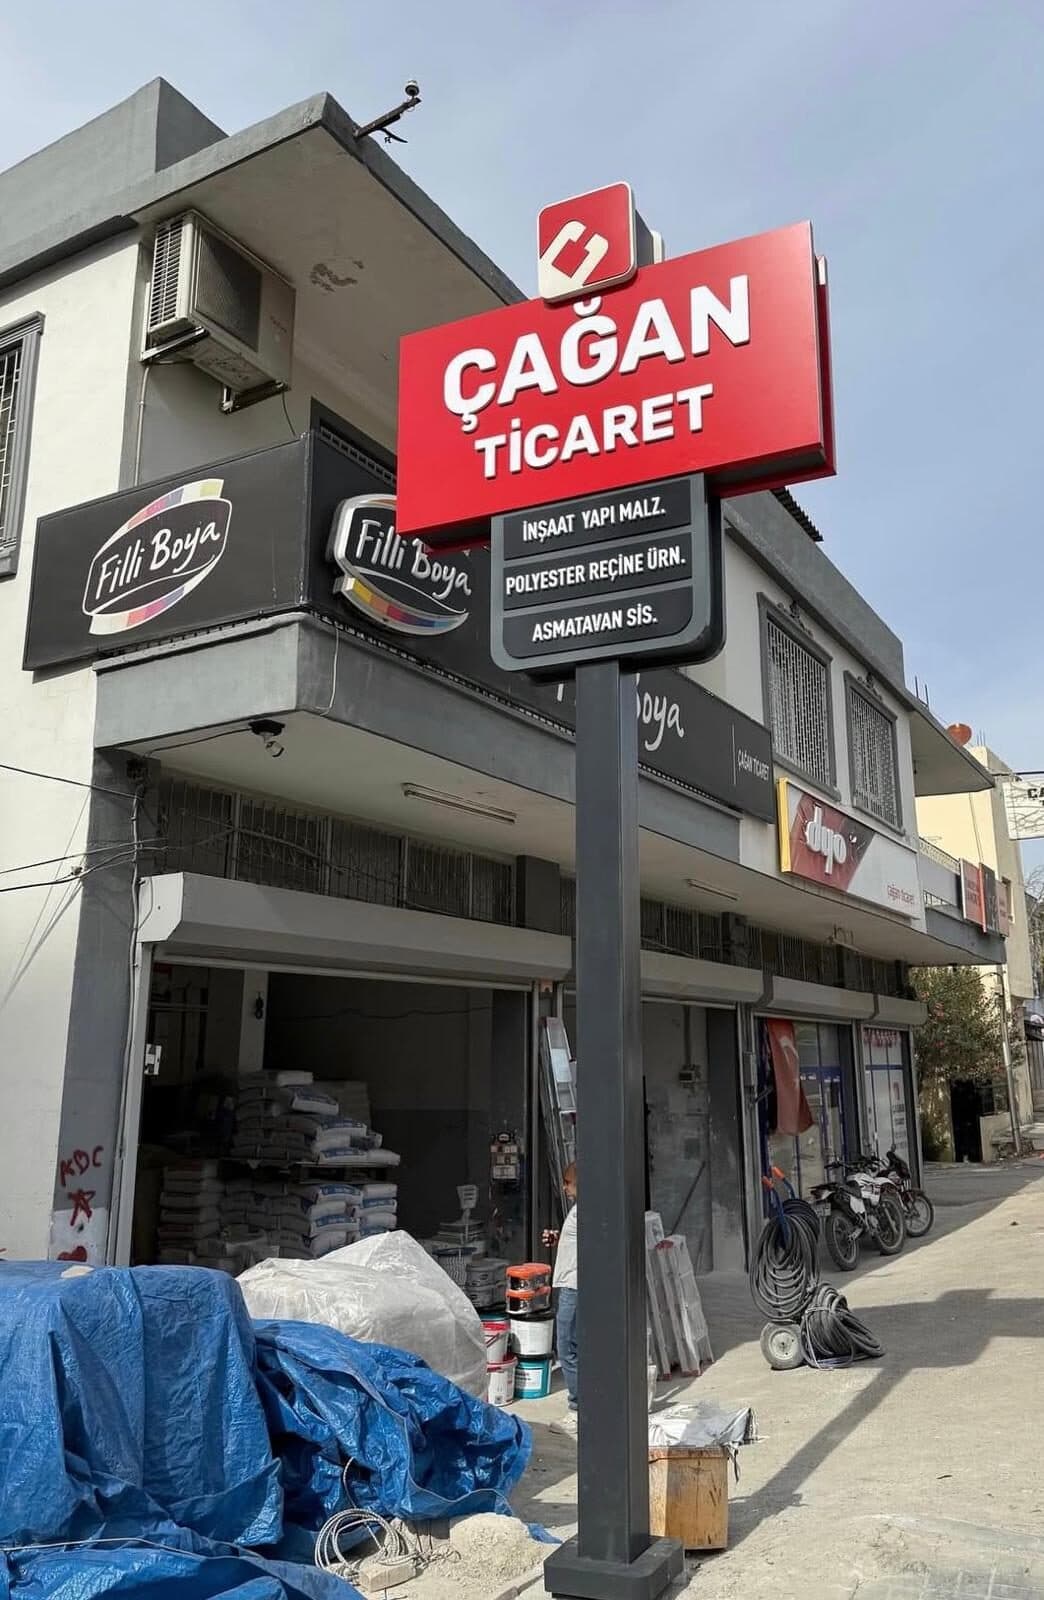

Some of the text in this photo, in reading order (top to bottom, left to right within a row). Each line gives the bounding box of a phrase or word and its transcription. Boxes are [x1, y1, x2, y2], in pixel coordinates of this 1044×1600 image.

[443, 274, 751, 431] ÇAĞAN
[475, 384, 714, 479] TİCARET
[523, 496, 666, 543] İNŞAAT YAPI MALZ.
[95, 521, 220, 600] Filli Boya
[355, 519, 471, 600] Filli Boya
[506, 545, 687, 595] POLYESTER REÇİNE ÜRN.
[532, 603, 658, 642] ASMATAVAN SİS.
[636, 672, 684, 751] oya
